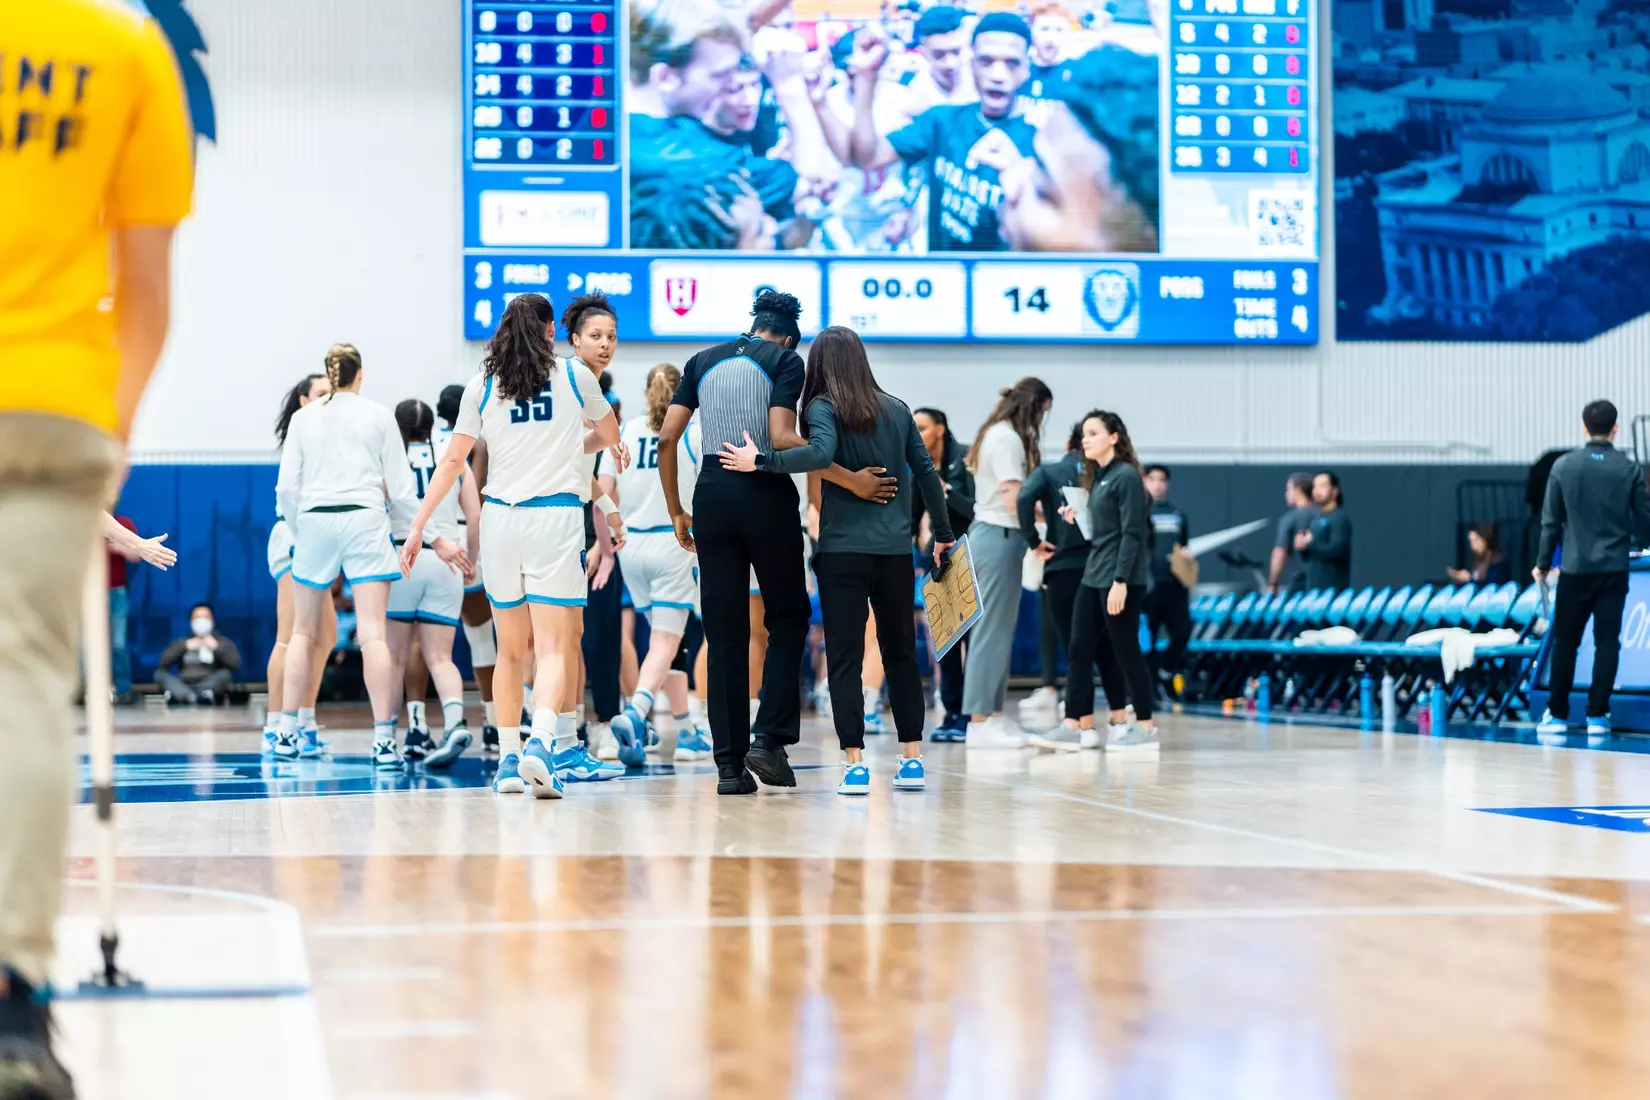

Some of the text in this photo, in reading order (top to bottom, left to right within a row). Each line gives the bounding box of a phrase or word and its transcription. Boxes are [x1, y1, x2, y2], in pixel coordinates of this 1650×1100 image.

[0, 54, 93, 104] NT
[862, 278, 933, 299] 00.0
[1292, 269, 1308, 295] 3
[1004, 287, 1050, 313] 14
